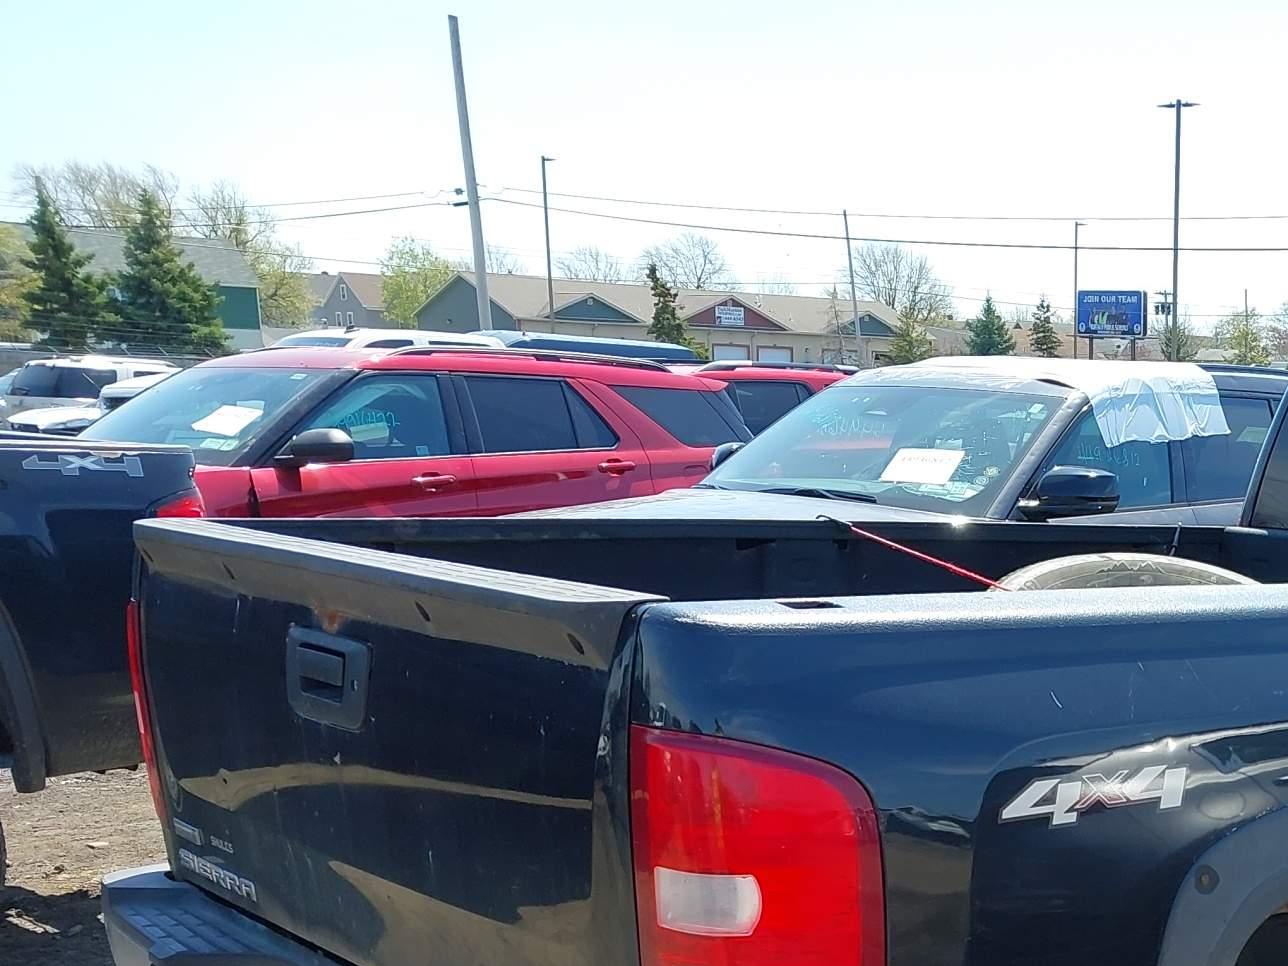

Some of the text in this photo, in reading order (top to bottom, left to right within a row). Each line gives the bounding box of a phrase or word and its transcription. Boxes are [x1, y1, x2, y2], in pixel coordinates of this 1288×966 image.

[1083, 295, 1138, 304] JOIN OUR TEAM
[179, 847, 257, 902] SIERRA
